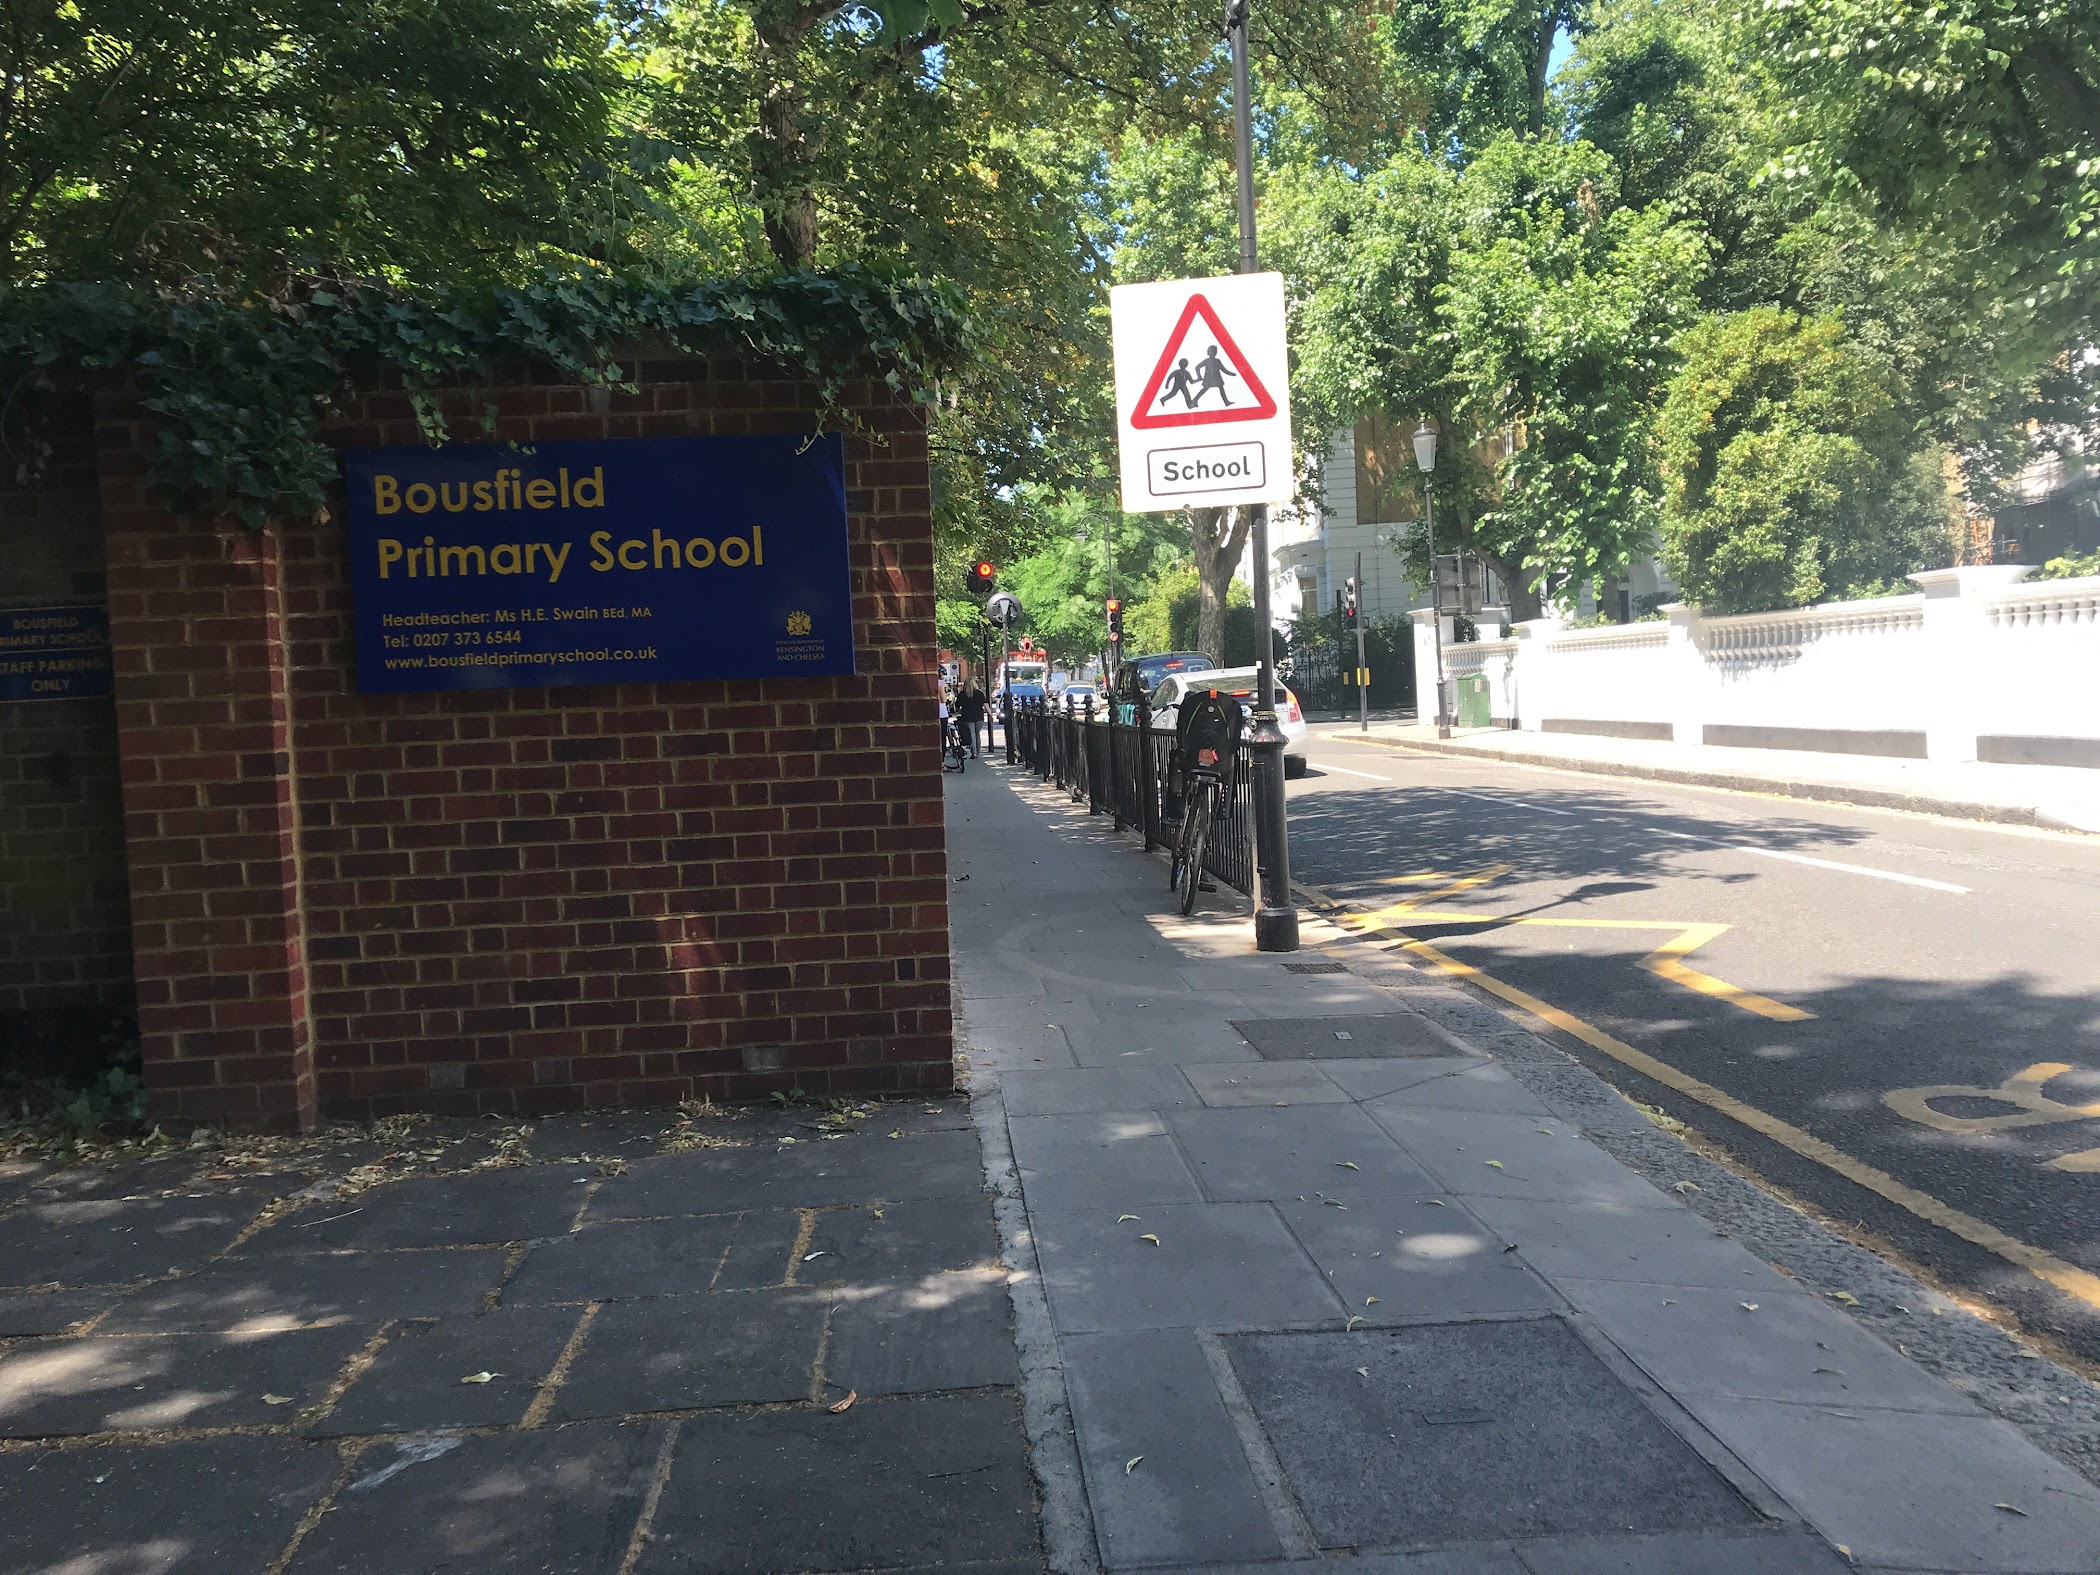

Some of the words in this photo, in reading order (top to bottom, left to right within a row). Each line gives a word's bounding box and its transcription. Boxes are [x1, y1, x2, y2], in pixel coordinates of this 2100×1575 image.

[1163, 456, 1251, 482] School
[374, 466, 605, 514] Bousfield
[377, 536, 572, 583] Primary
[589, 525, 764, 572] School
[382, 611, 490, 627] Headteacher:
[495, 610, 517, 623] Ms
[521, 608, 549, 622] H.E.
[553, 606, 599, 621] Swain
[631, 607, 653, 618] MA
[383, 634, 409, 648] Tel:
[413, 632, 450, 647] 0207
[454, 631, 481, 646] 373
[485, 630, 522, 645] 6544
[776, 645, 825, 653] KENSINGTON
[385, 645, 658, 670] www.bousfieldprimaryschool.co.uk
[794, 653, 826, 661] CHELSEA
[31, 678, 71, 692] ONLY
